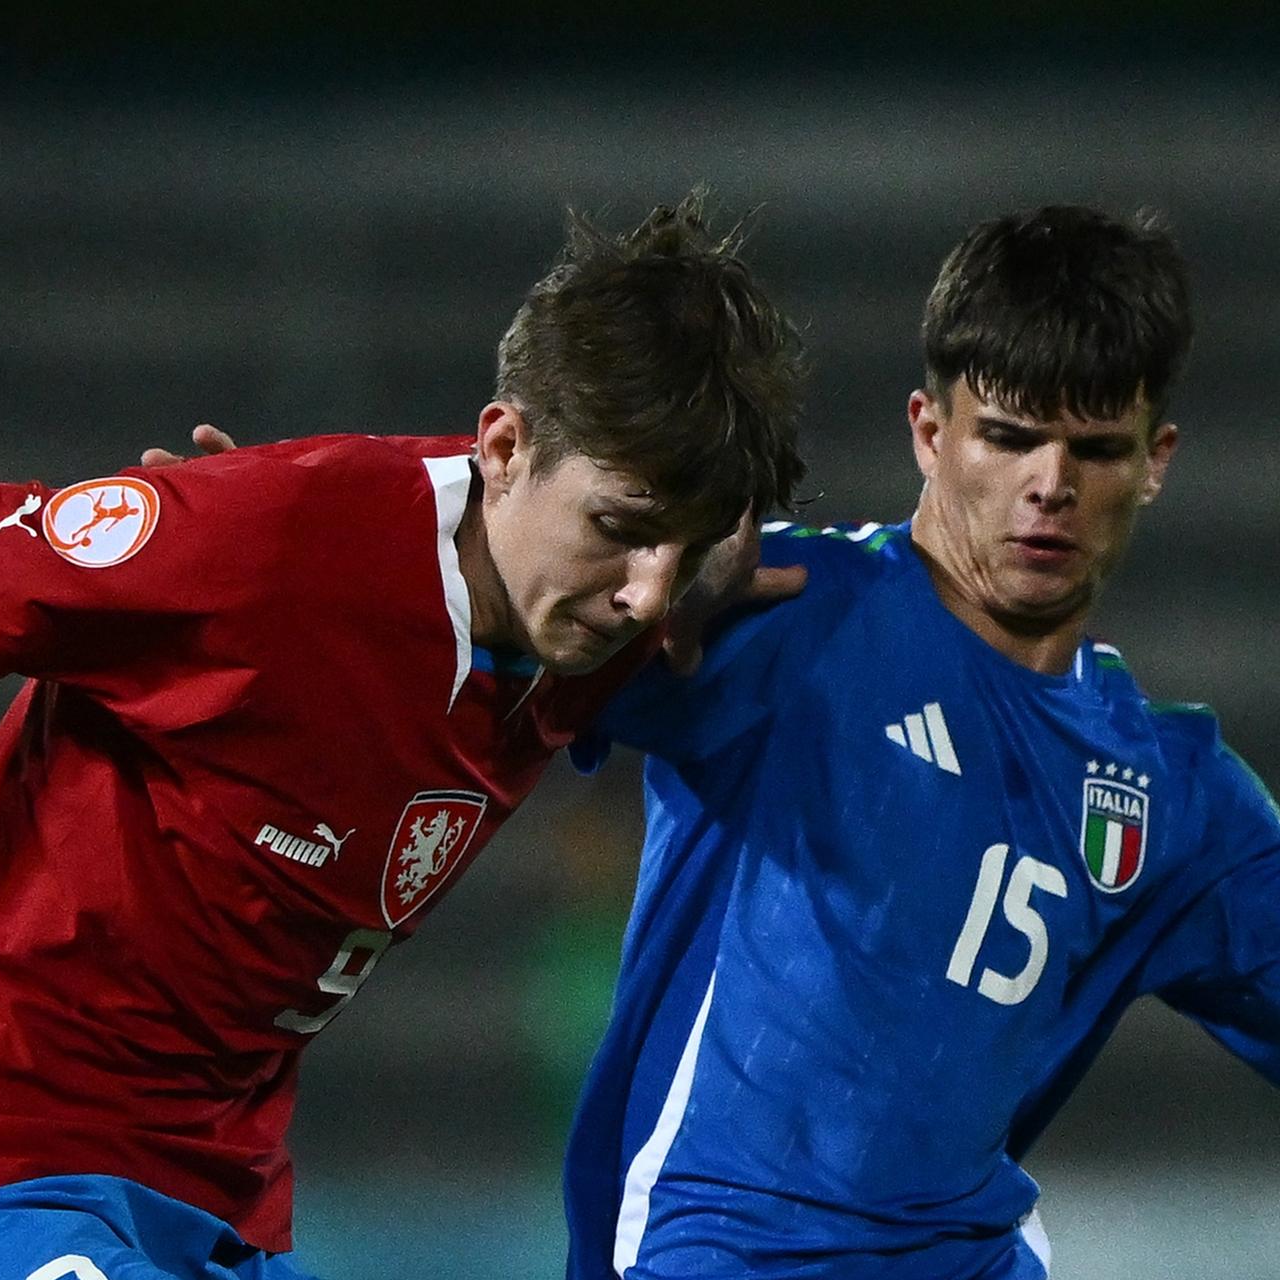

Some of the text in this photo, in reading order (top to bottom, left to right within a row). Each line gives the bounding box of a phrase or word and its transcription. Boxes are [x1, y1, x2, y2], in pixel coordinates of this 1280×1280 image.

[1089, 785, 1141, 819] ITALIA
[254, 824, 331, 868] PUMA
[946, 844, 1067, 1005] 15
[273, 928, 392, 1034] 9
